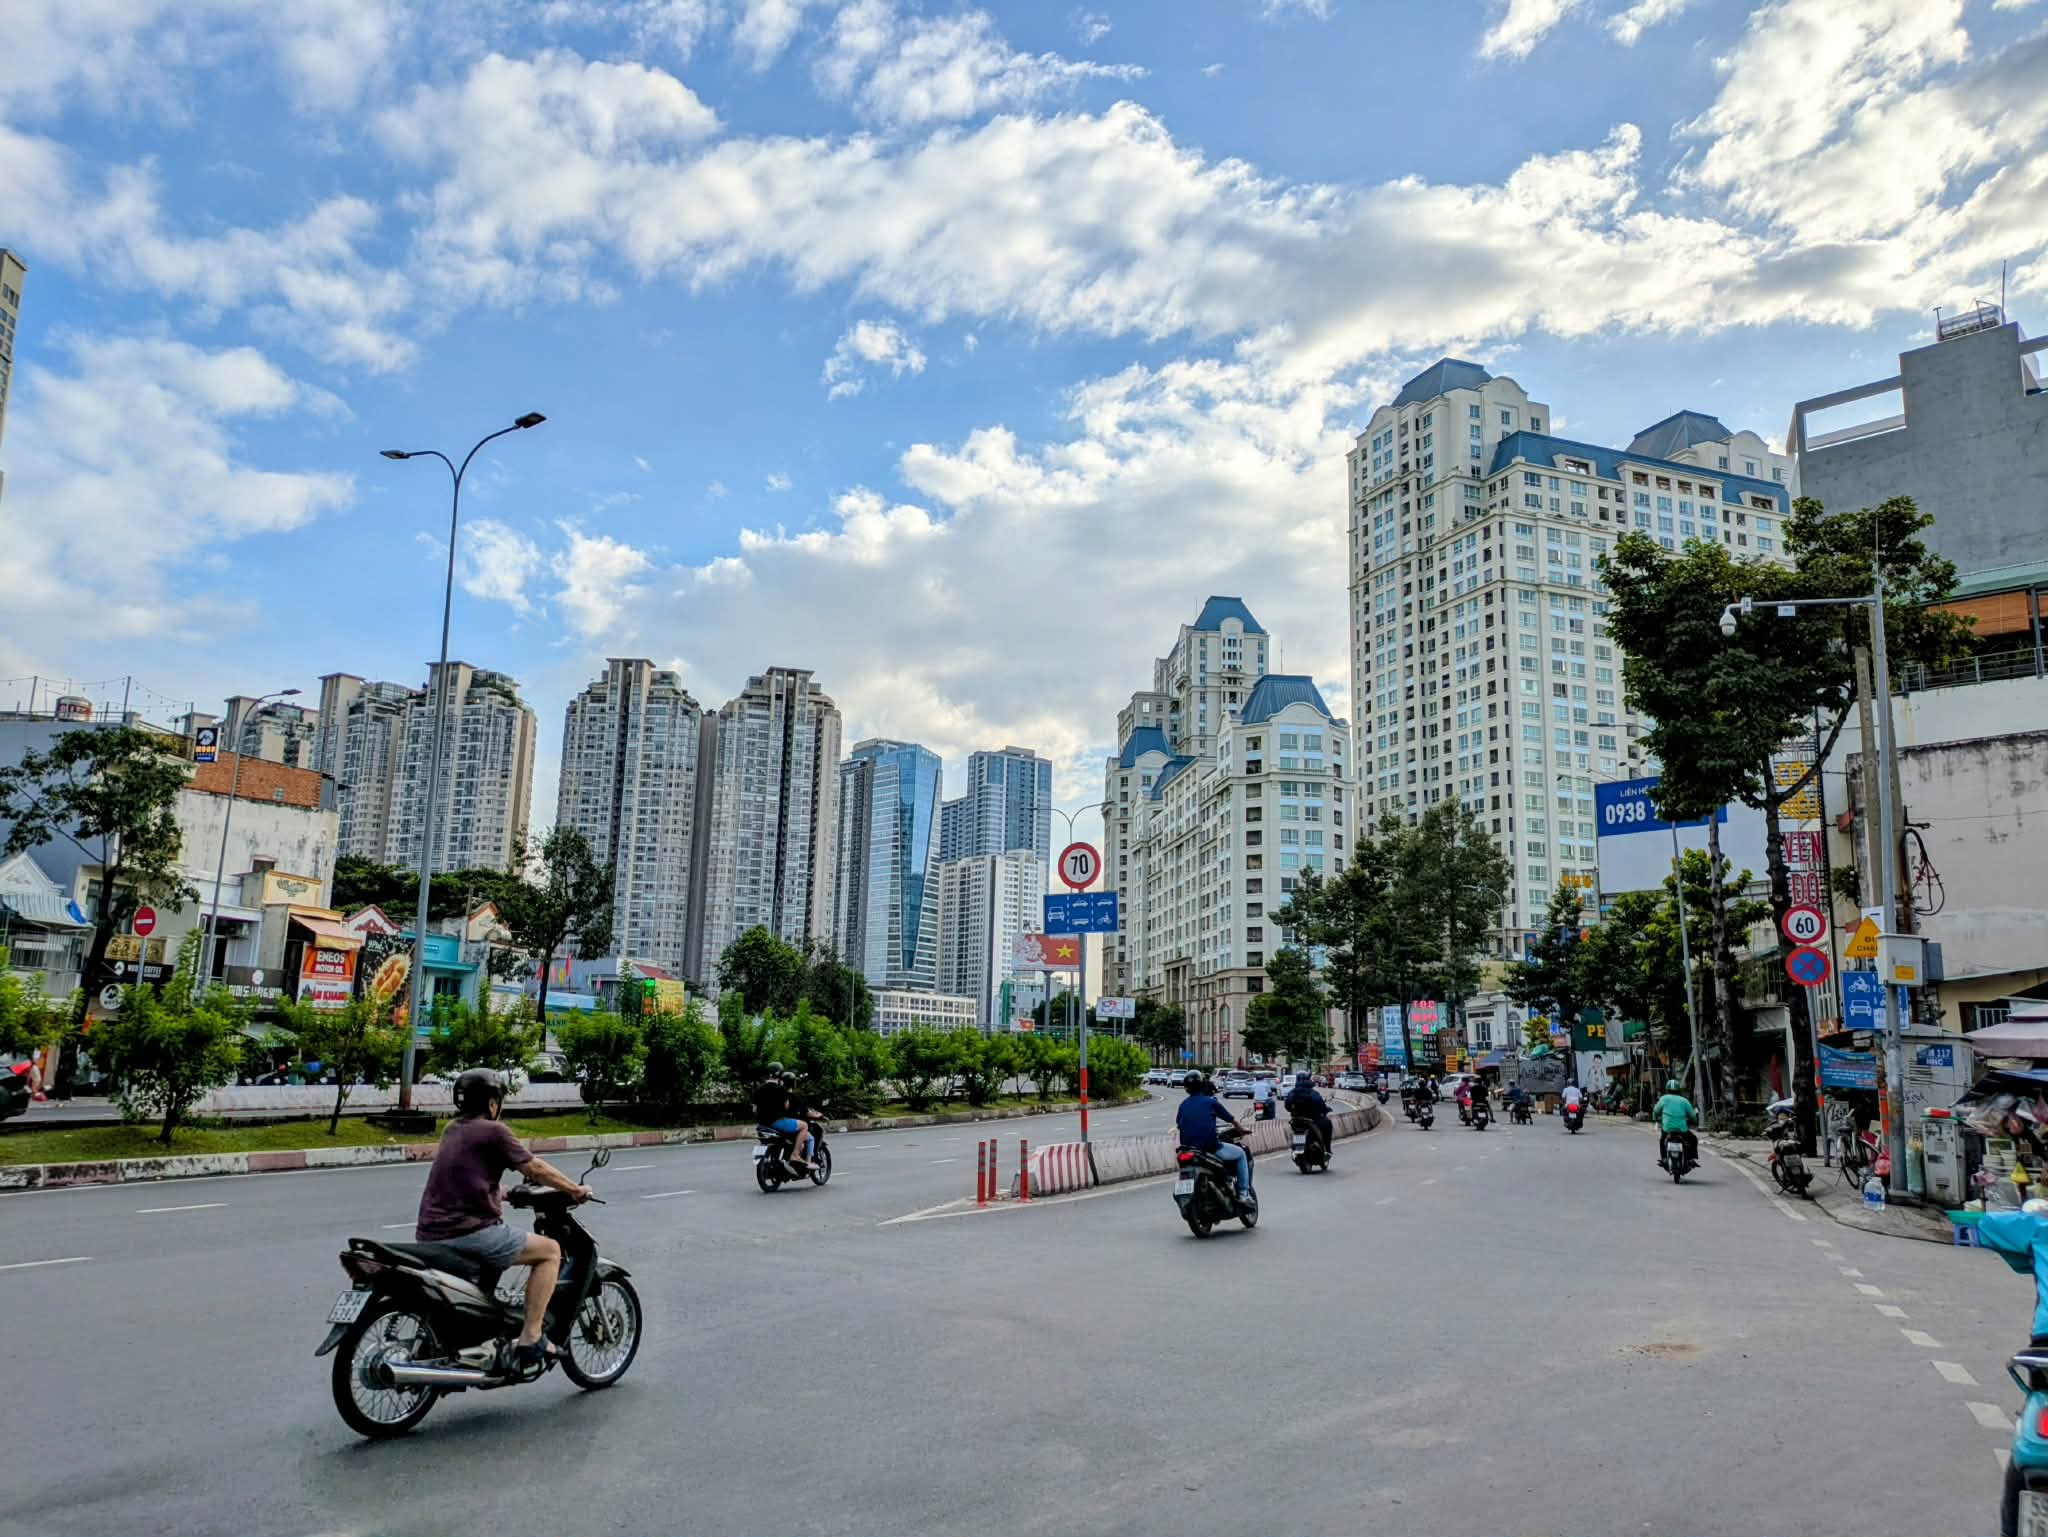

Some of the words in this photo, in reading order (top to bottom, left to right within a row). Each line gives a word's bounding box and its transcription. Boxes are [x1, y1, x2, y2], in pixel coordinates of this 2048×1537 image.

[1605, 800, 1646, 824] 0938
[1071, 854, 1089, 876] 70
[1795, 917, 1814, 934] 60
[316, 950, 345, 963] ENEOS
[1936, 1048, 1951, 1058] 117
